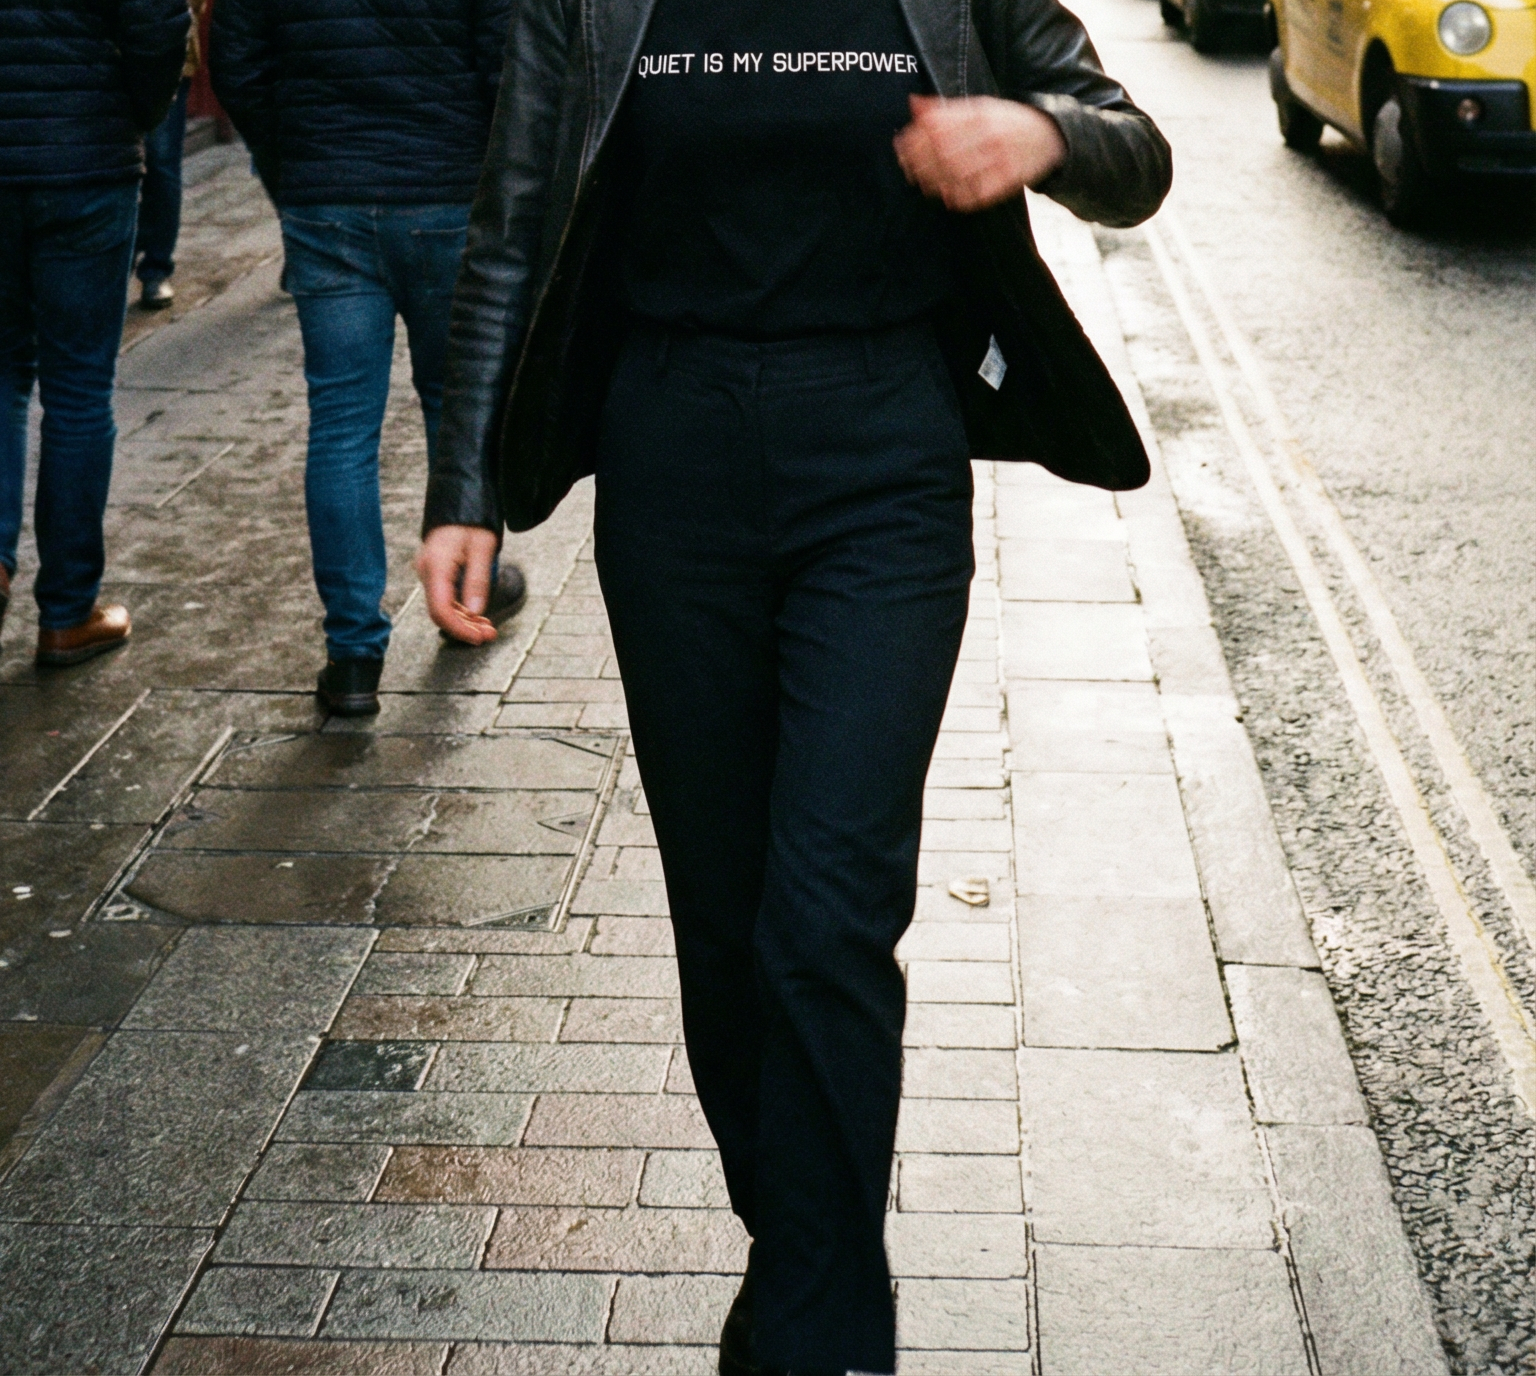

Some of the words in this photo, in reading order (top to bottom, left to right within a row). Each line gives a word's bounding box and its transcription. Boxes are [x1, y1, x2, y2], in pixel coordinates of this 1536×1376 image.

[639, 53, 695, 78] QUIET
[704, 53, 723, 73] IS
[733, 52, 763, 73] MY
[772, 51, 918, 74] SUPERPOWER
